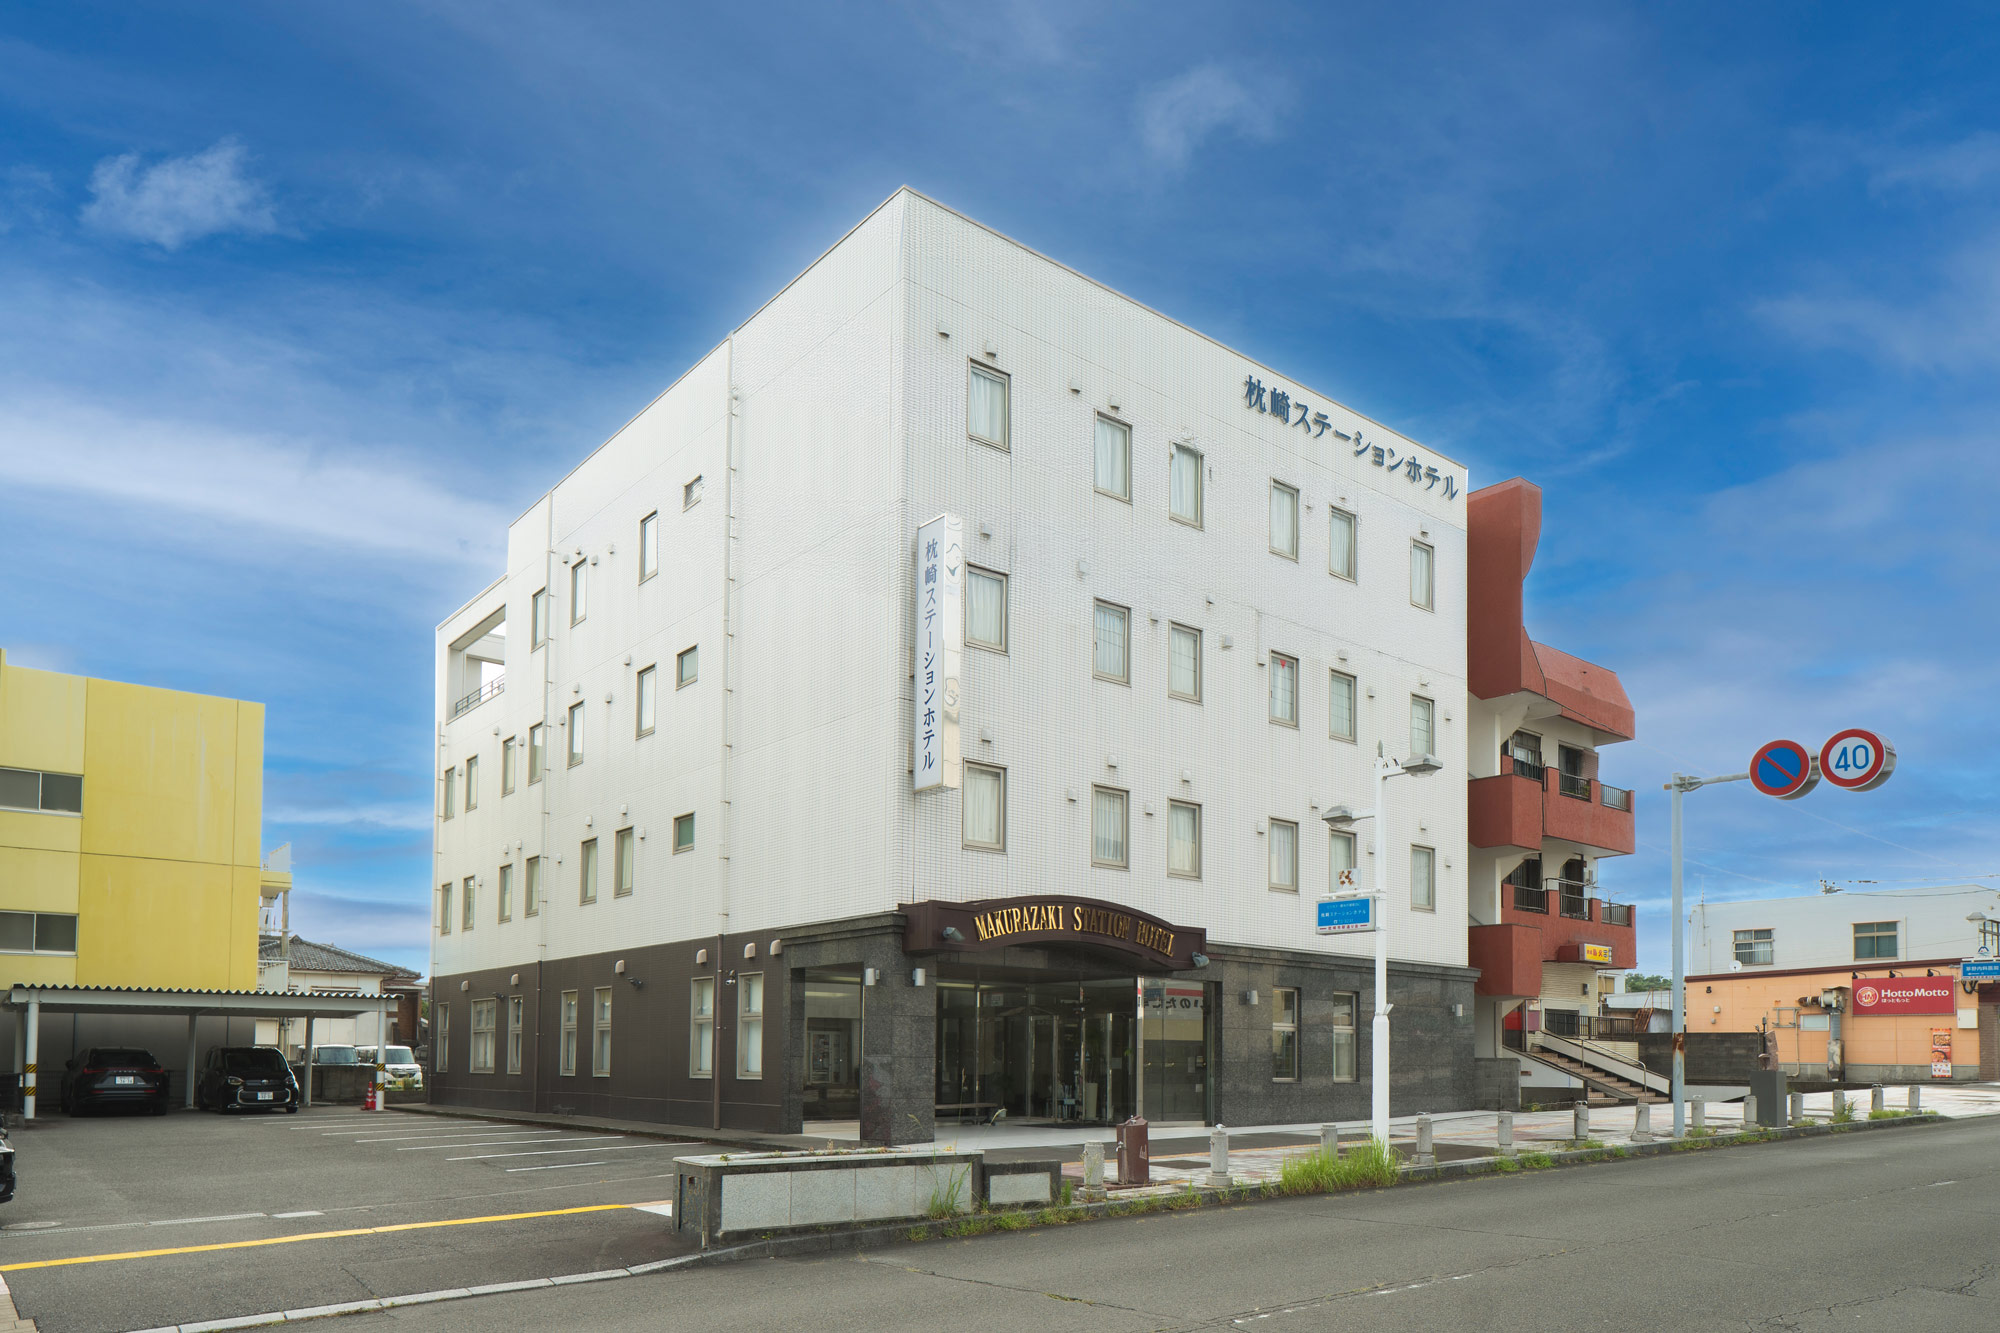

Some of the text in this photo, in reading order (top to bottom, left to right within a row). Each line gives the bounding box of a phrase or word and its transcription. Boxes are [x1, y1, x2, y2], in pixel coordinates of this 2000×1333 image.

[1244, 374, 1459, 500] 枕崎ステーションホテル
[922, 538, 938, 771] 枕崎ステーションホテル
[1835, 744, 1869, 772] 40
[974, 905, 1175, 957] MAKURAZAKI STATION HOTEL
